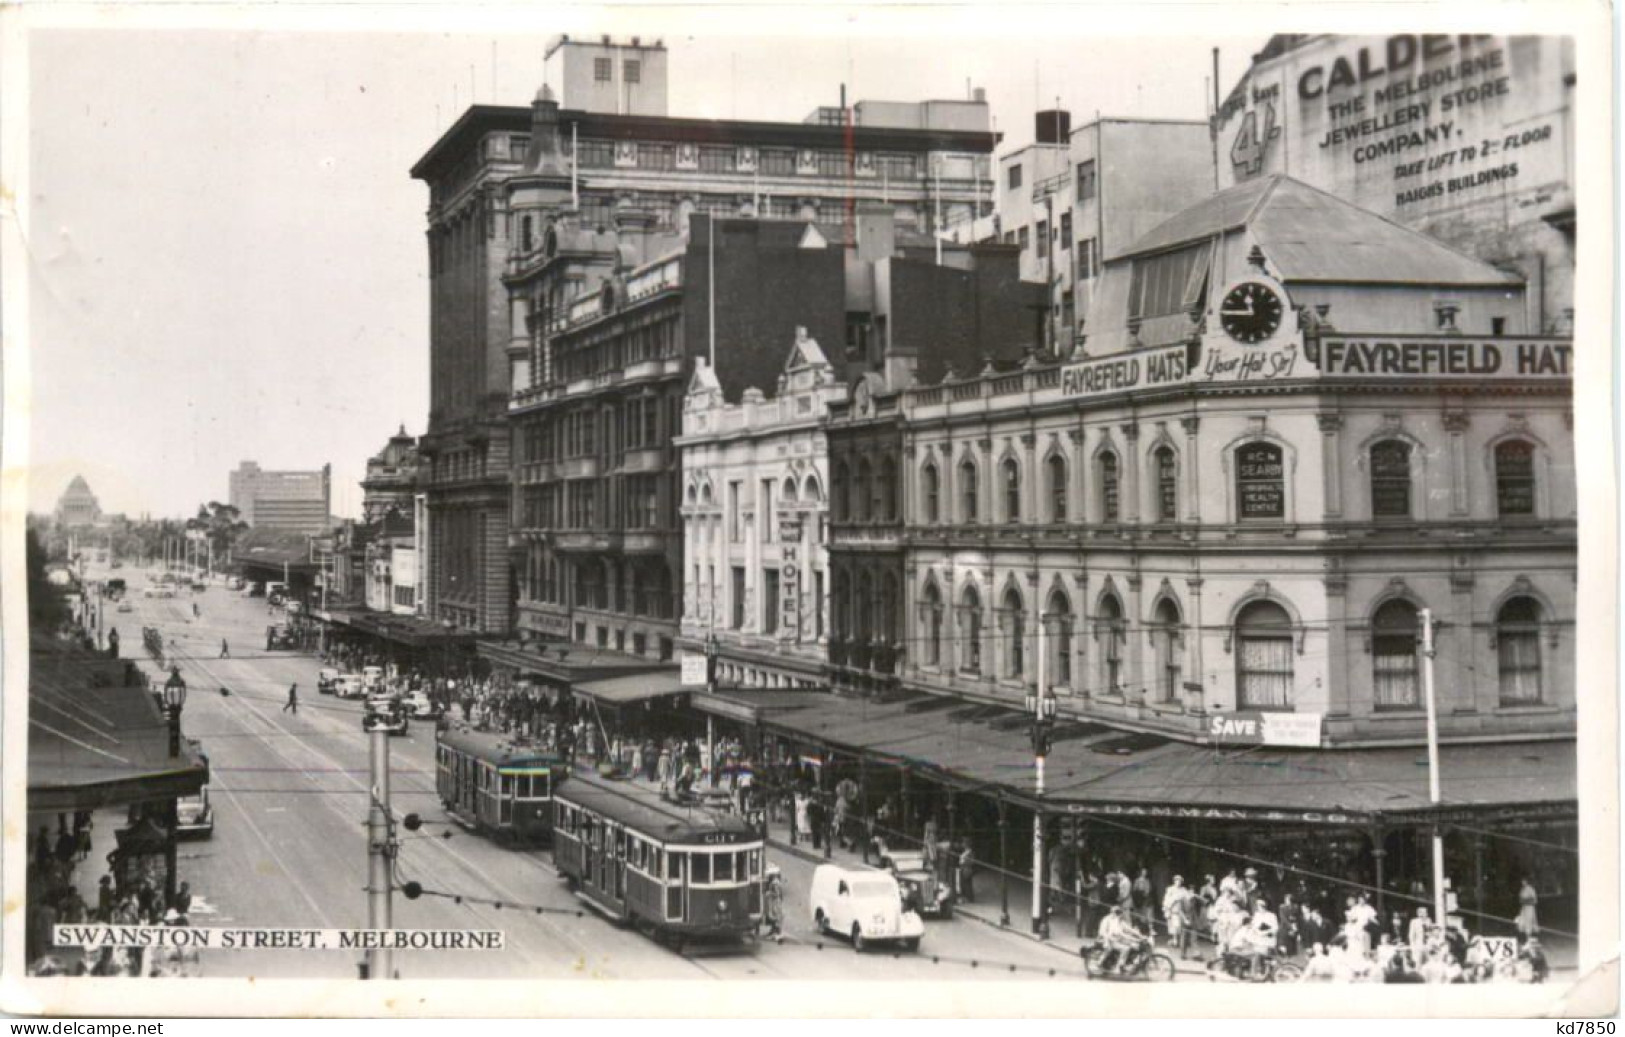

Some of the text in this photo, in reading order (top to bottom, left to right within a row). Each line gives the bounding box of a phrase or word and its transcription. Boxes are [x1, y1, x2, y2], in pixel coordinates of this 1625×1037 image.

[1328, 48, 1504, 120] THE MELBOURNE
[1319, 76, 1510, 149] JEWELLERY STORE
[1393, 160, 1425, 180] TAKE
[1428, 150, 1457, 172] LIFT
[1460, 145, 1477, 163] TO
[1503, 124, 1552, 151] FLOOR
[1448, 162, 1519, 194] BUILDINGS
[1062, 350, 1185, 396] FAYREFIELD HATS
[1237, 351, 1267, 380] Hat
[1325, 343, 1573, 375] FAYREFIELD HAT
[783, 546, 797, 628] HOTEL
[1210, 715, 1257, 736] SAVE
[1103, 804, 1248, 819] DAMMAN
[704, 834, 735, 844] CITY
